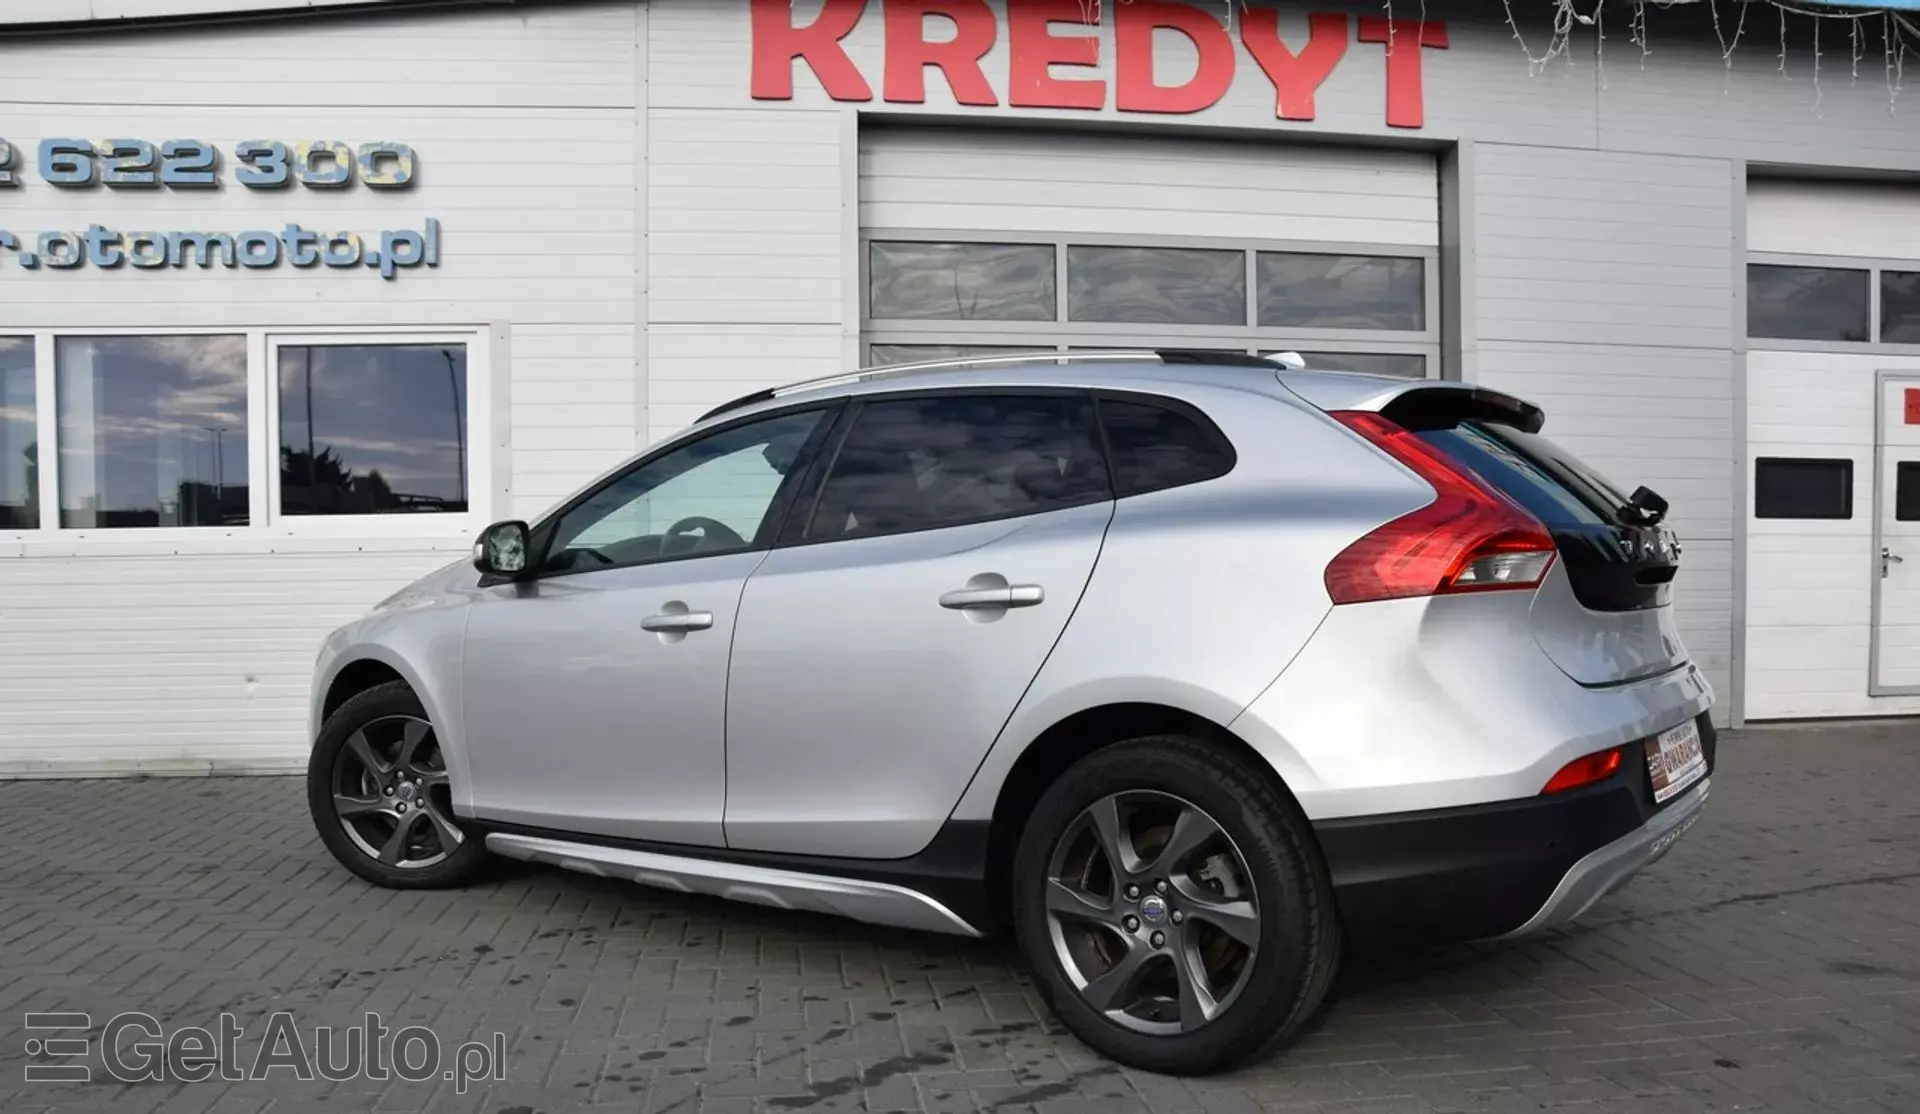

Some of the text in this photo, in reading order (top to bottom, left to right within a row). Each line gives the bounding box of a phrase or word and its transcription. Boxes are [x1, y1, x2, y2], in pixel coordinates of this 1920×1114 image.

[750, 0, 1449, 128] KREDYT
[38, 138, 218, 187] 622
[235, 140, 418, 187] 300
